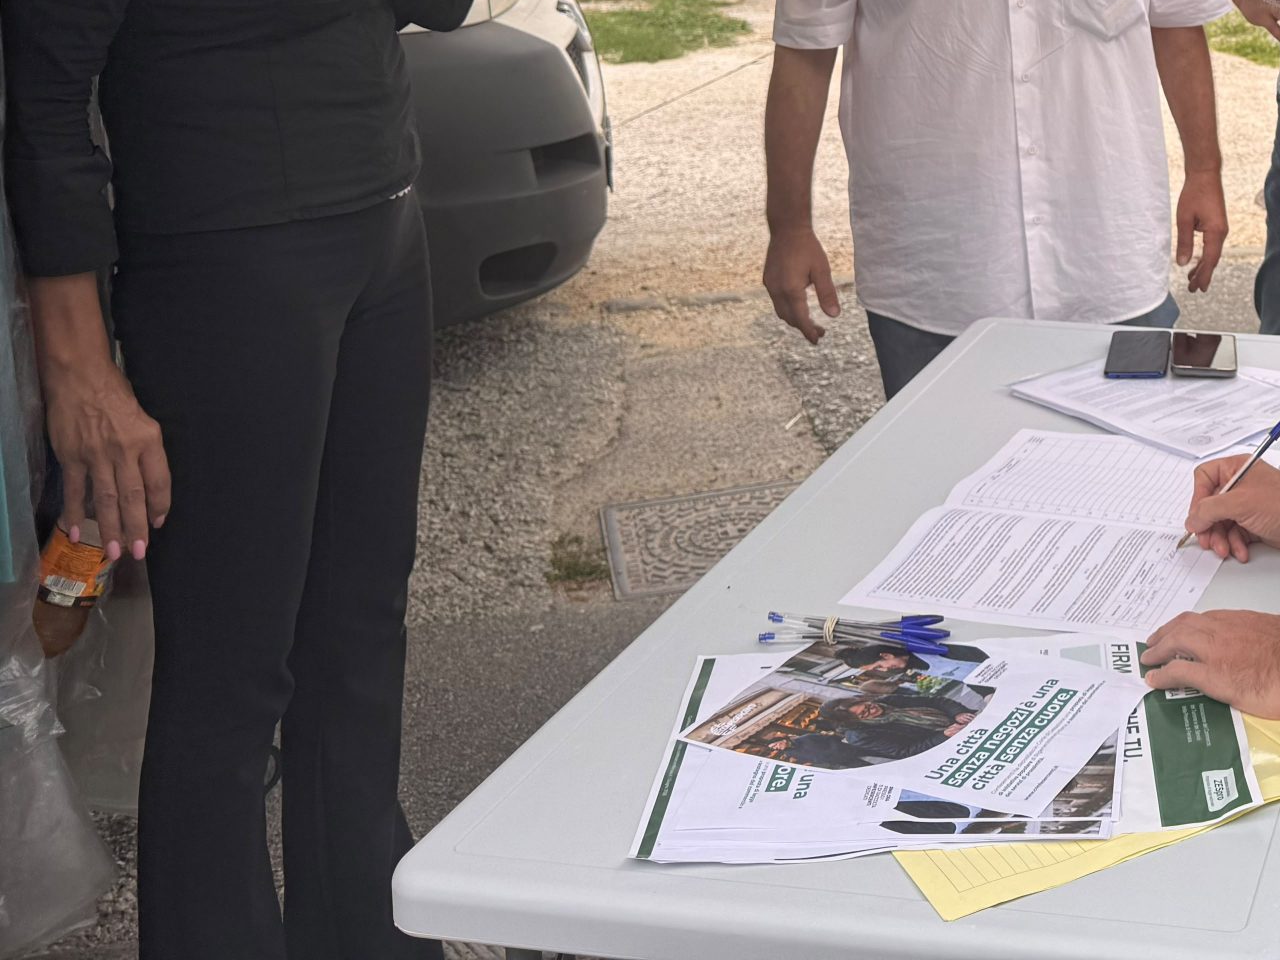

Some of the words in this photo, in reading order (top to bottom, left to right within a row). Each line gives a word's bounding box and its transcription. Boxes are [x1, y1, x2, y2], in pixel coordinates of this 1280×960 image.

[948, 751, 990, 786] senza
[984, 708, 1030, 748] negozi
[1032, 678, 1059, 699] una
[971, 764, 1006, 790] città
[1000, 726, 1040, 762] senza
[1034, 690, 1074, 726] cuore.
[924, 757, 960, 780] Una
[956, 727, 988, 755] città
[1124, 738, 1142, 762] TU.
[770, 766, 791, 790] ore.
[792, 774, 814, 800] una
[1214, 780, 1224, 801] ZESpro
